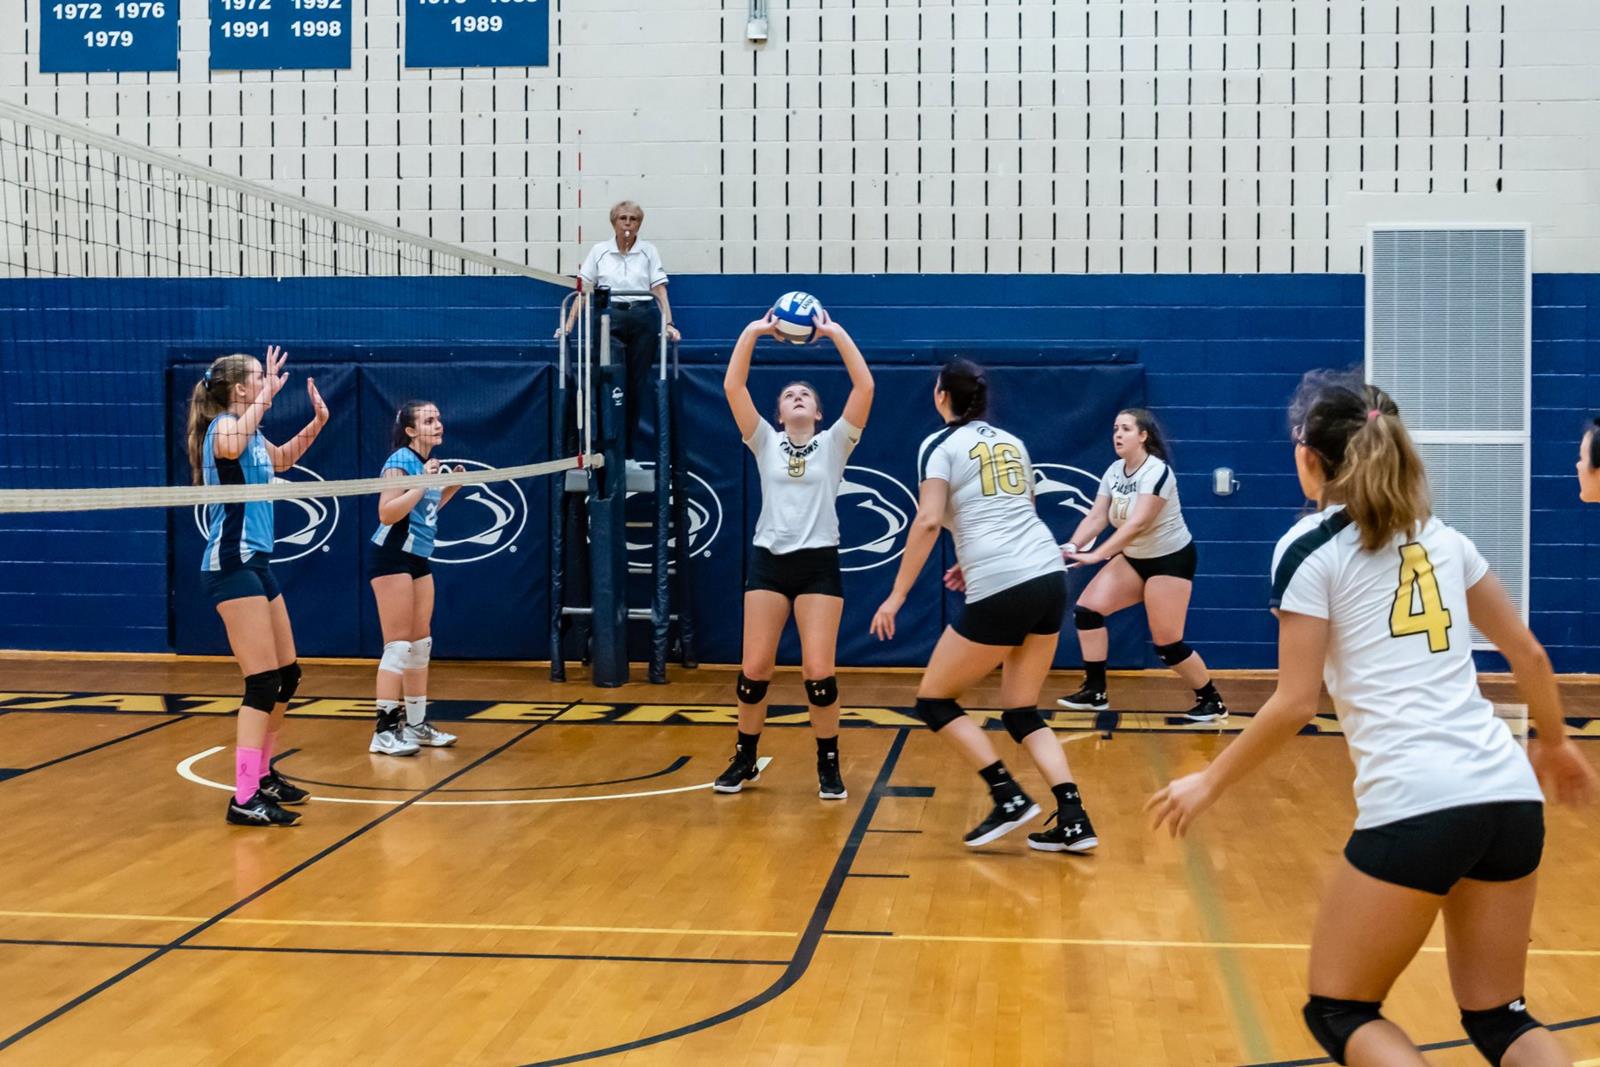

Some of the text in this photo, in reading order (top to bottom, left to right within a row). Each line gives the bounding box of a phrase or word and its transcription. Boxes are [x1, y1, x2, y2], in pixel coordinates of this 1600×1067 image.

[52, 2, 165, 20] 1972 1976
[221, 0, 271, 10] 1972
[221, 20, 341, 38] 1991 1998
[451, 15, 503, 32] 1989
[83, 31, 133, 47] 1979
[788, 455, 806, 478] 9
[969, 441, 1026, 497] 16
[1389, 542, 1452, 653] 4
